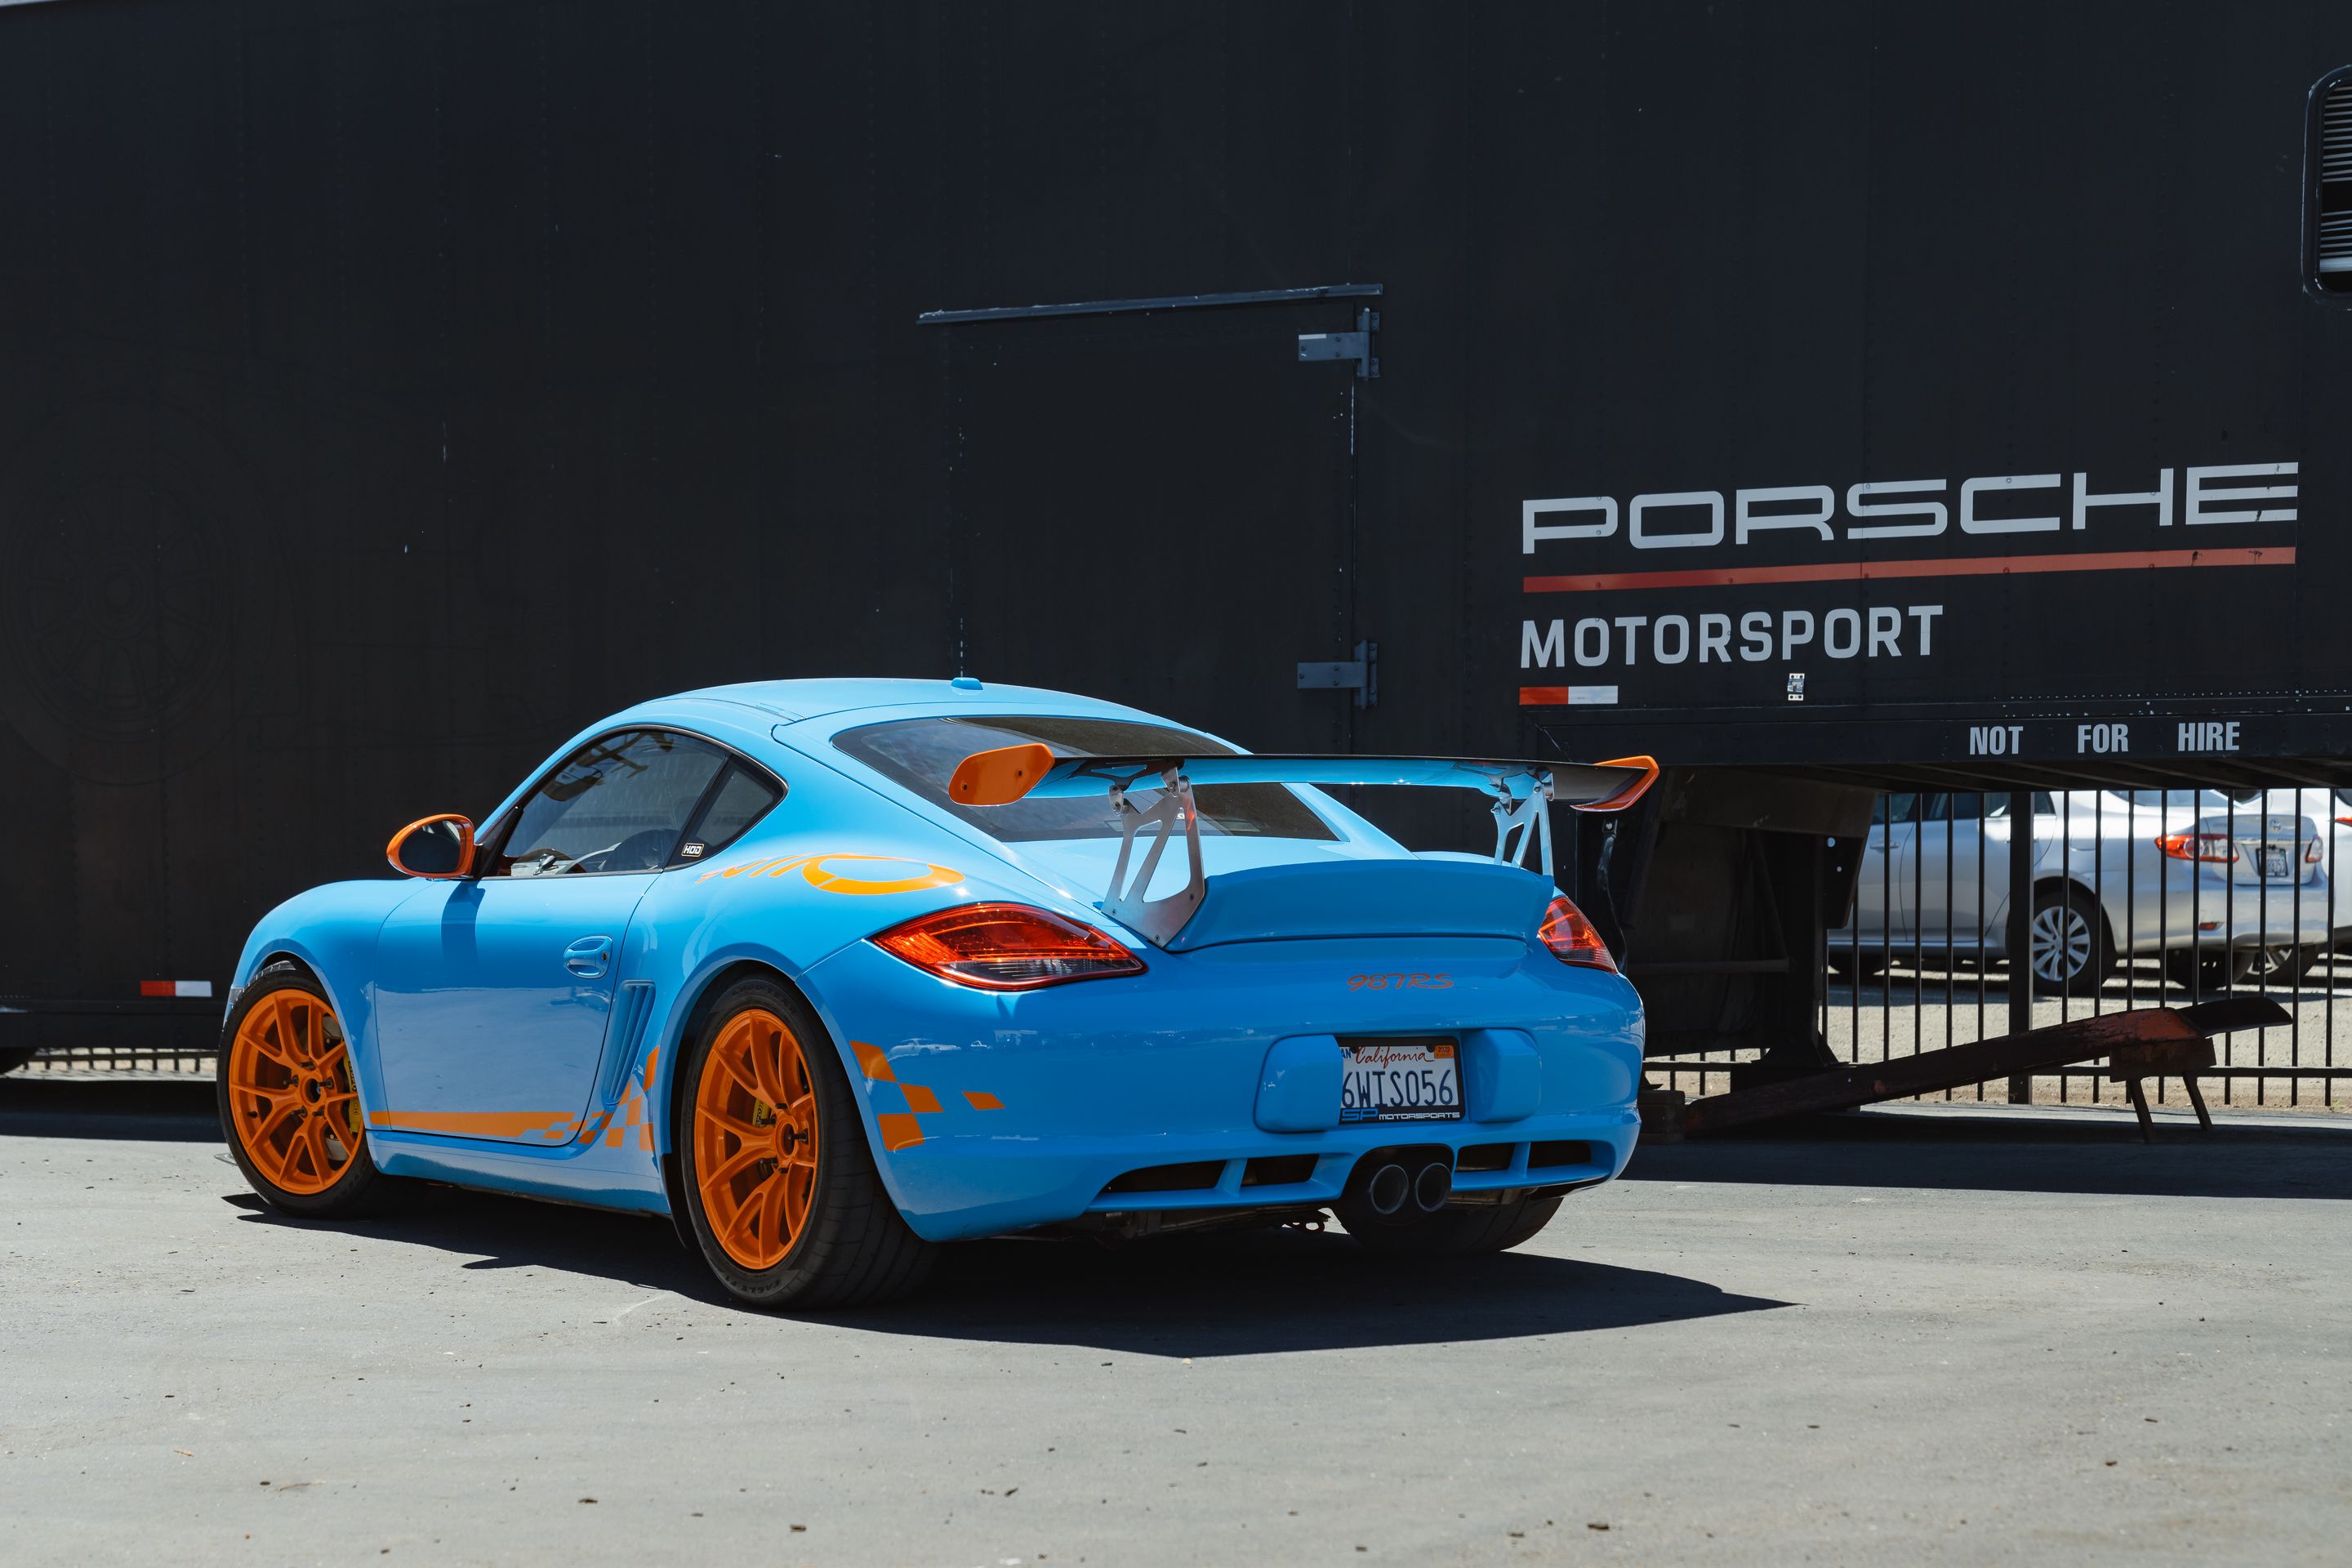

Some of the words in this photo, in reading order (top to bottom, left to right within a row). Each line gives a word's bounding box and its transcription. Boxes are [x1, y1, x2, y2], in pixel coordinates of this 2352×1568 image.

[1523, 462, 2298, 554] PORSCHE
[1520, 606, 1943, 669] MOTORSPORT
[1970, 726, 2024, 755] NOT
[2078, 724, 2129, 753] FOR
[2178, 721, 2240, 751] HIRE
[1348, 973, 1454, 991] 987RS
[1356, 1046, 1435, 1068] California
[1342, 1070, 1454, 1107] 6WIS056
[1379, 1111, 1460, 1120] MOTORSPORTS
